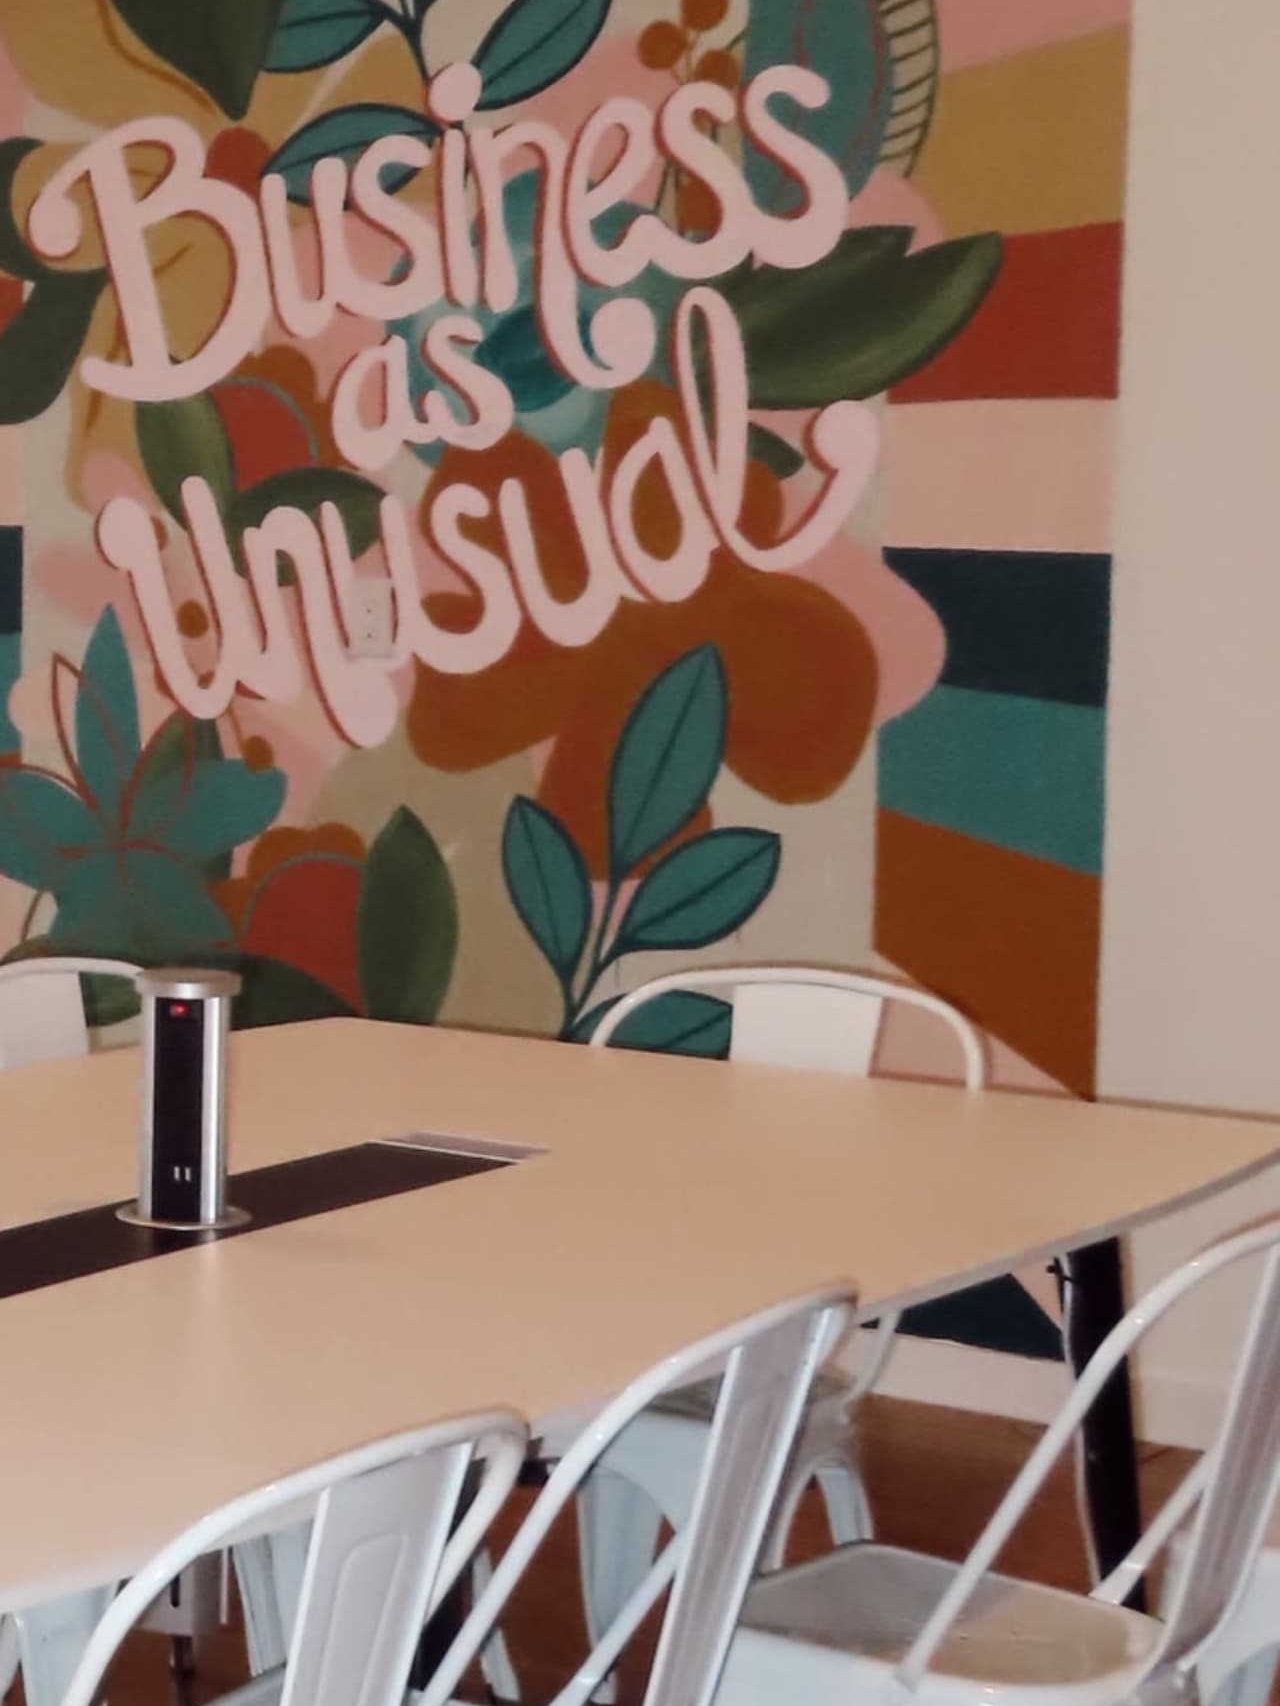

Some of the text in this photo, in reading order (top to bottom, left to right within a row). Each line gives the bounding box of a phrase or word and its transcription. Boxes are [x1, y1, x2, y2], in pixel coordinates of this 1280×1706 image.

[28, 62, 849, 403] Business
[331, 314, 516, 472] as
[93, 285, 881, 749] Unusual
